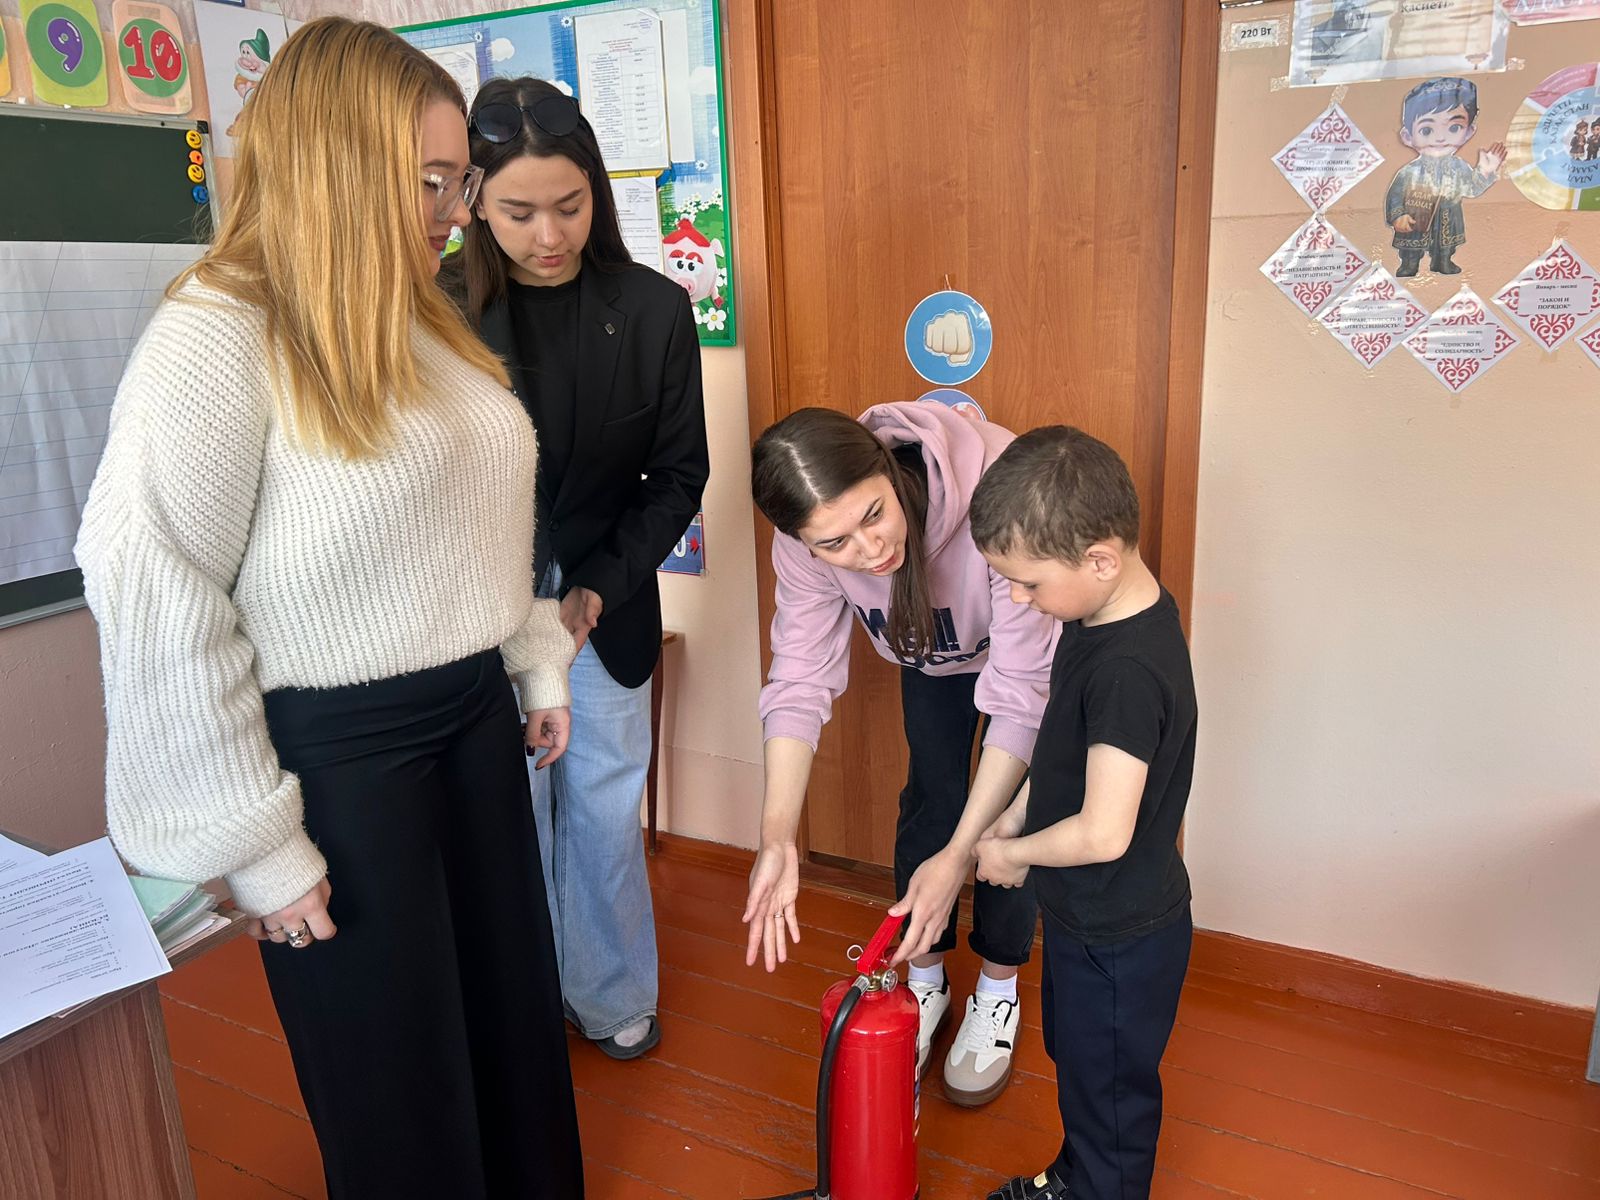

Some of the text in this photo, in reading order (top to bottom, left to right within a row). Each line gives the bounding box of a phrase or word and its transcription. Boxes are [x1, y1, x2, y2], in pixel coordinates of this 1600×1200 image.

[47, 17, 84, 73] 9
[123, 26, 182, 82] 10
[1240, 26, 1272, 39] 220 Вт
